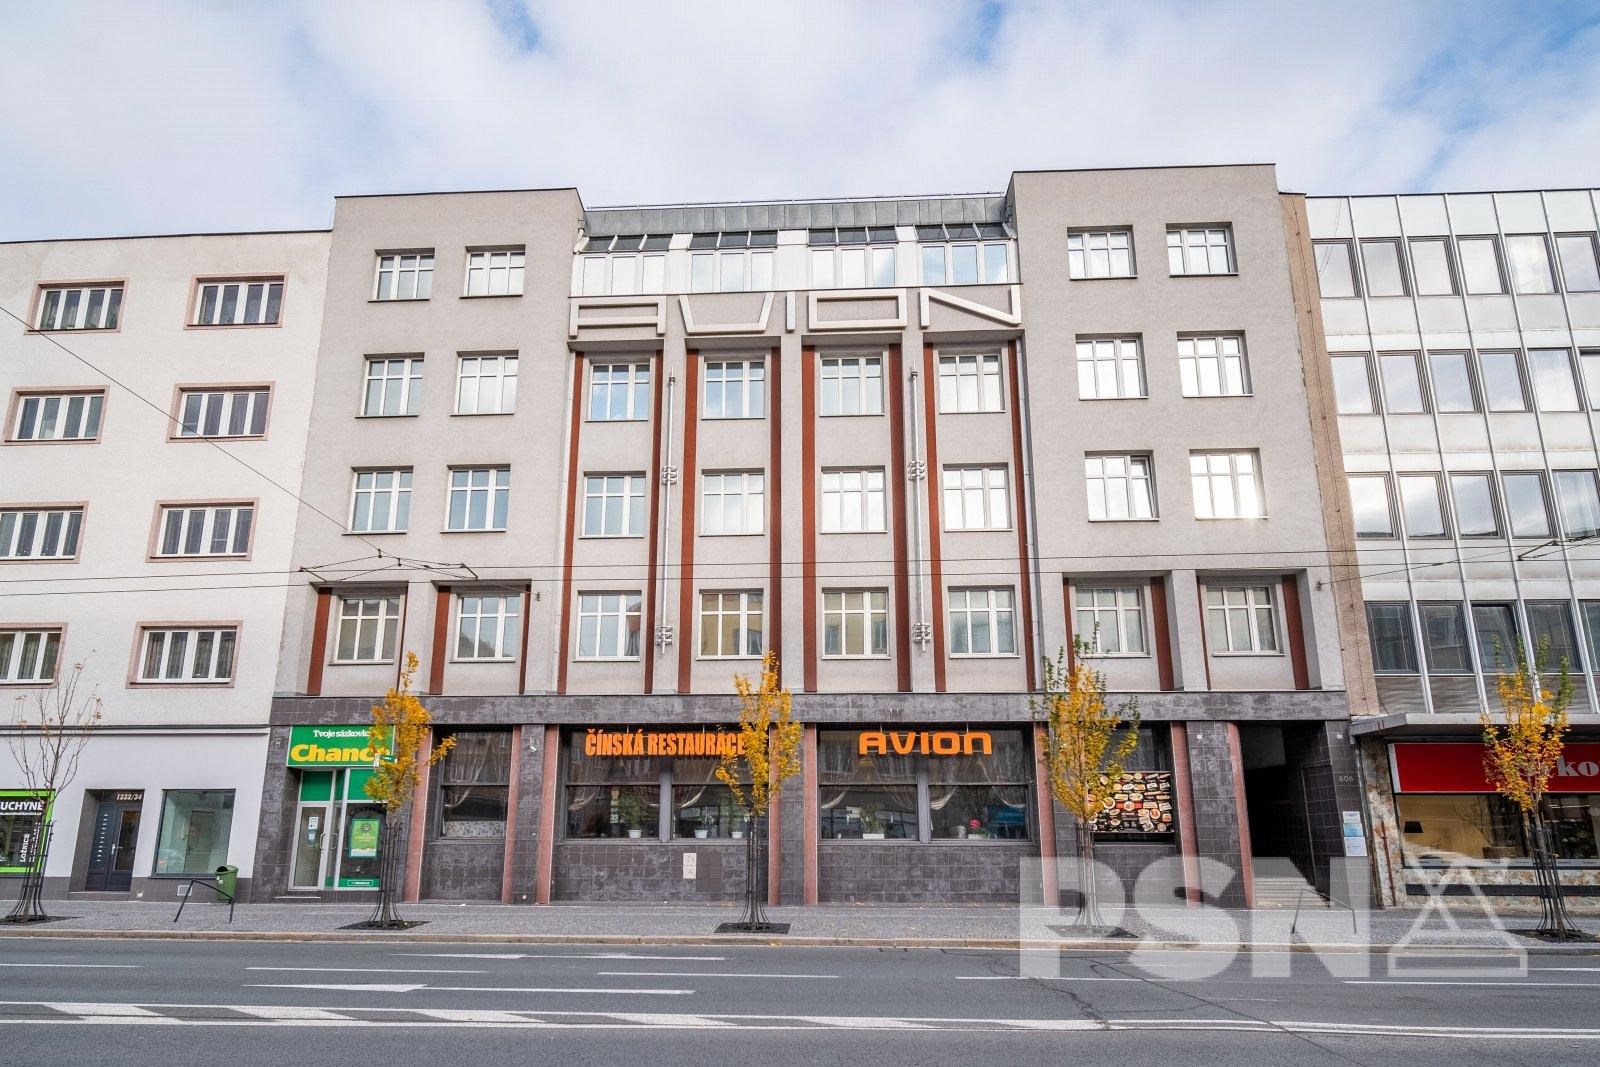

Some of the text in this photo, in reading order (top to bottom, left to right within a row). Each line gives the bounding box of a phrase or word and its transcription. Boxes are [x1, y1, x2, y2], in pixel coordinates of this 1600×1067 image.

[313, 729, 335, 739] Tvoje
[585, 728, 746, 756] ČÍNSKÁ RESTAURACE
[859, 732, 992, 755] AVION
[1557, 755, 1600, 777] ko
